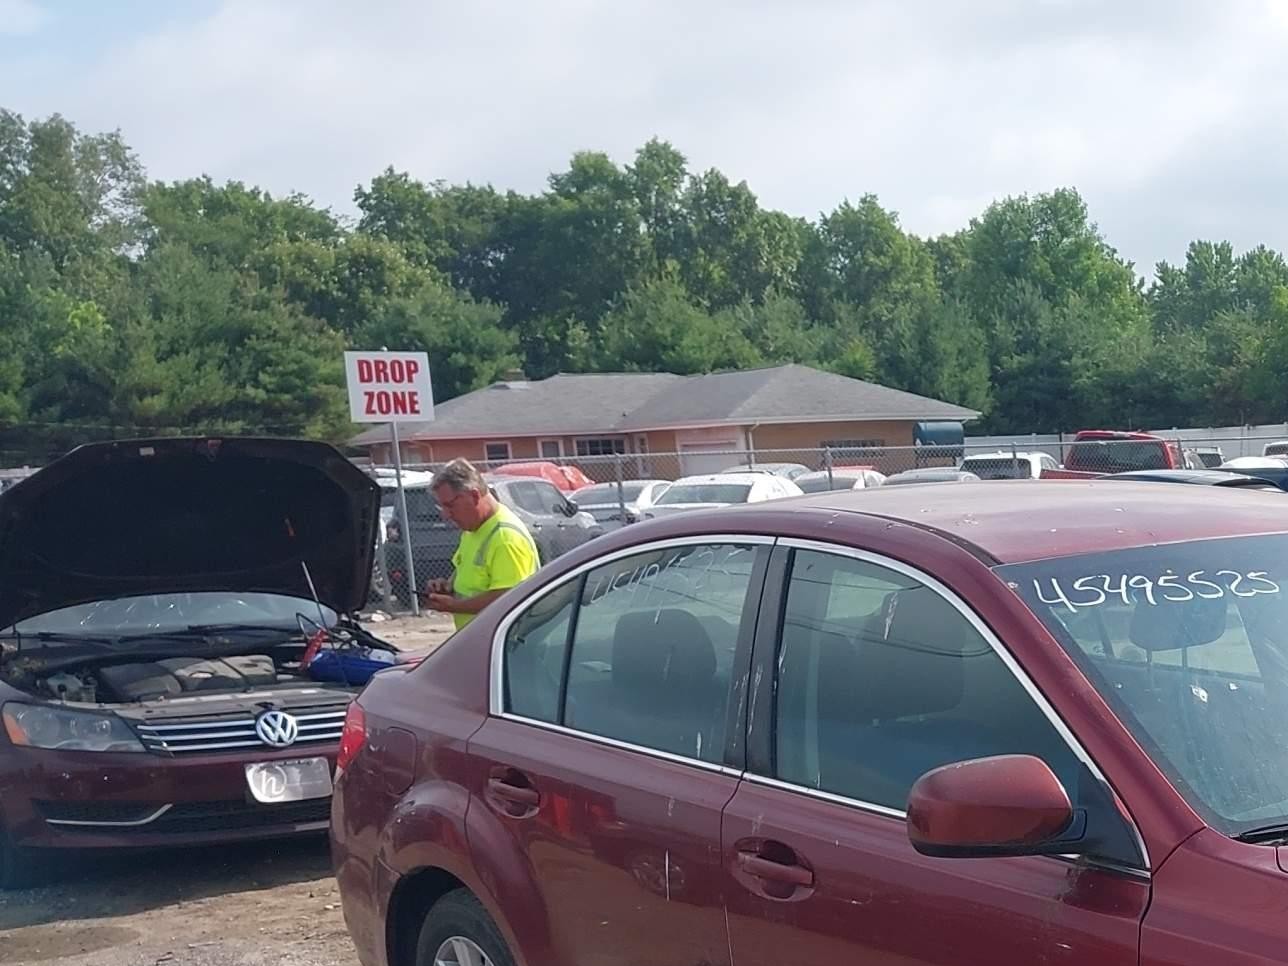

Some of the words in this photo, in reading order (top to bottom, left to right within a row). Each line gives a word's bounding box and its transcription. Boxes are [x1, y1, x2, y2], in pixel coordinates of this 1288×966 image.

[357, 359, 419, 383] DROP
[364, 391, 420, 415] ZONE
[1033, 569, 1280, 613] 45495525
